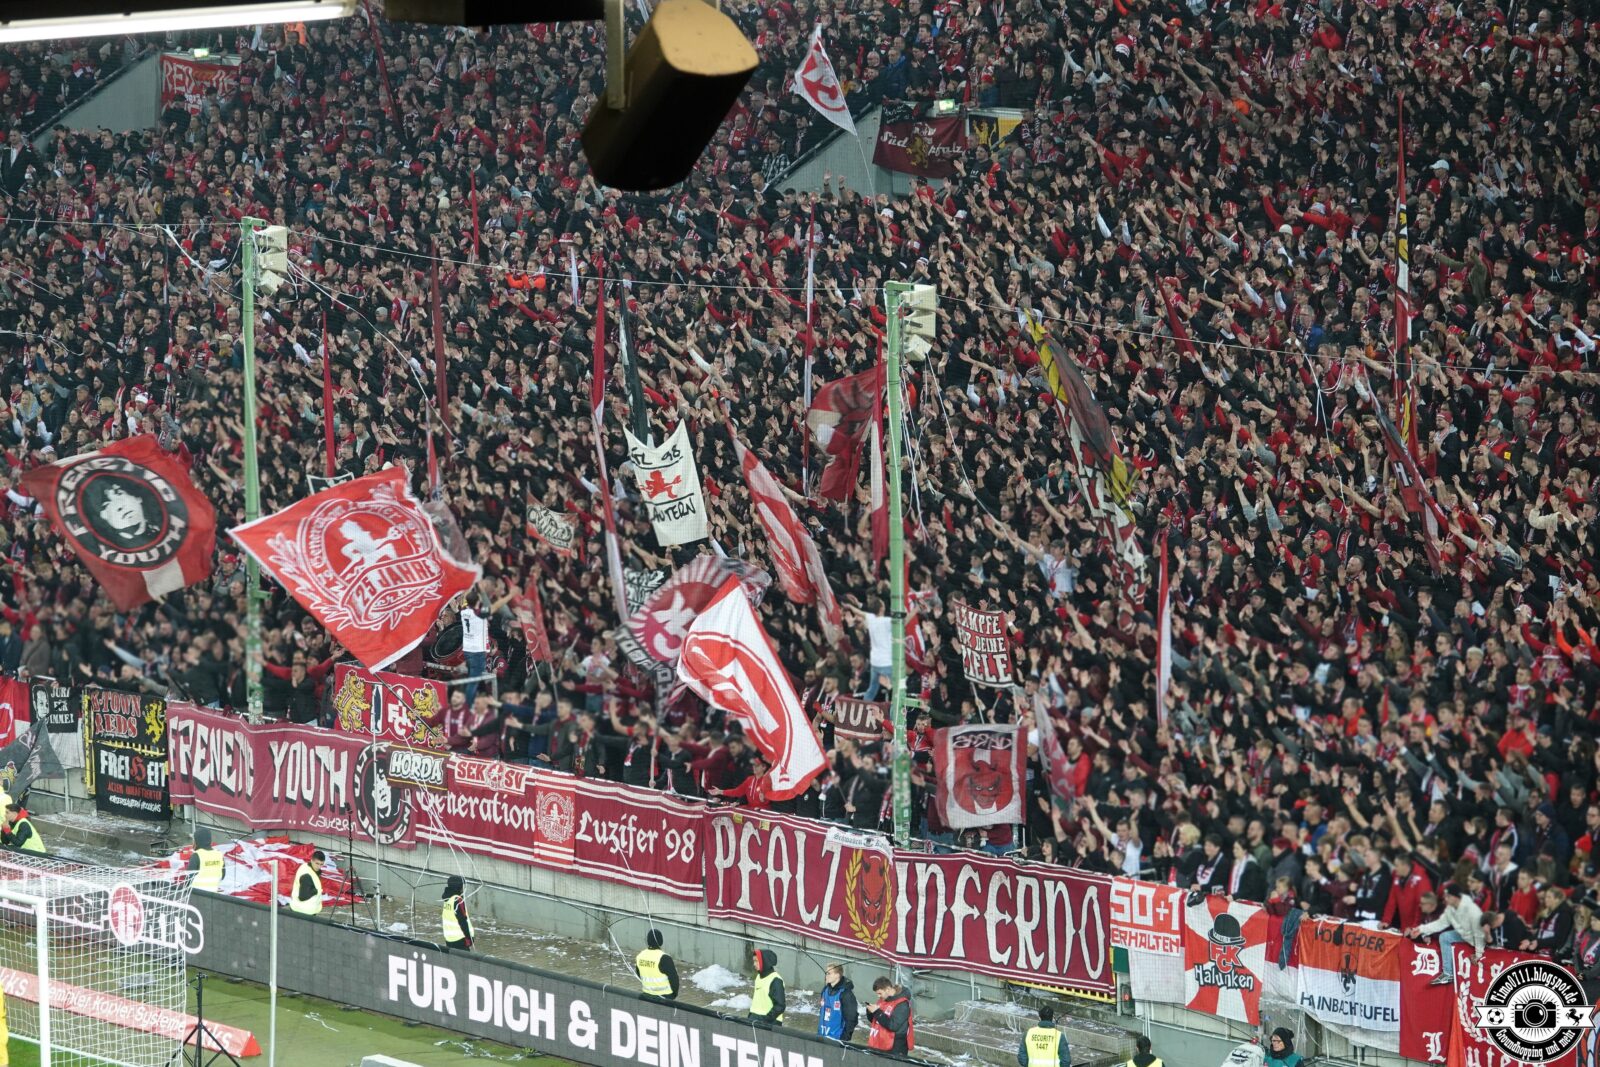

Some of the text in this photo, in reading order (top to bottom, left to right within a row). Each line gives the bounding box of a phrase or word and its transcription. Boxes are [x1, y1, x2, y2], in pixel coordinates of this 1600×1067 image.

[651, 497, 696, 523] AUTERN
[98, 514, 187, 565] YOUTH
[355, 577, 377, 605] 25
[974, 636, 1007, 653] DEINE
[91, 690, 142, 718] K-TOWN
[835, 703, 879, 730] NUR
[95, 713, 138, 738] REDS
[269, 740, 348, 810] YOUTH
[389, 750, 444, 784] HORDA
[456, 760, 487, 781] SEK
[504, 769, 525, 791] SV
[575, 810, 658, 858] Luzifer
[711, 815, 842, 934] PFALZ
[896, 860, 1106, 980] INFERNO
[1111, 880, 1181, 931] 50+1
[1110, 928, 1181, 954] ERHALTEN
[1314, 926, 1385, 953] HOCHDER
[1194, 963, 1254, 991] Halunken
[49, 986, 91, 1009] emmler
[388, 952, 824, 1067] FÜR DICH & DEIN TE
[820, 1024, 831, 1036] TV
[1031, 1033, 1055, 1044] SECURITY
